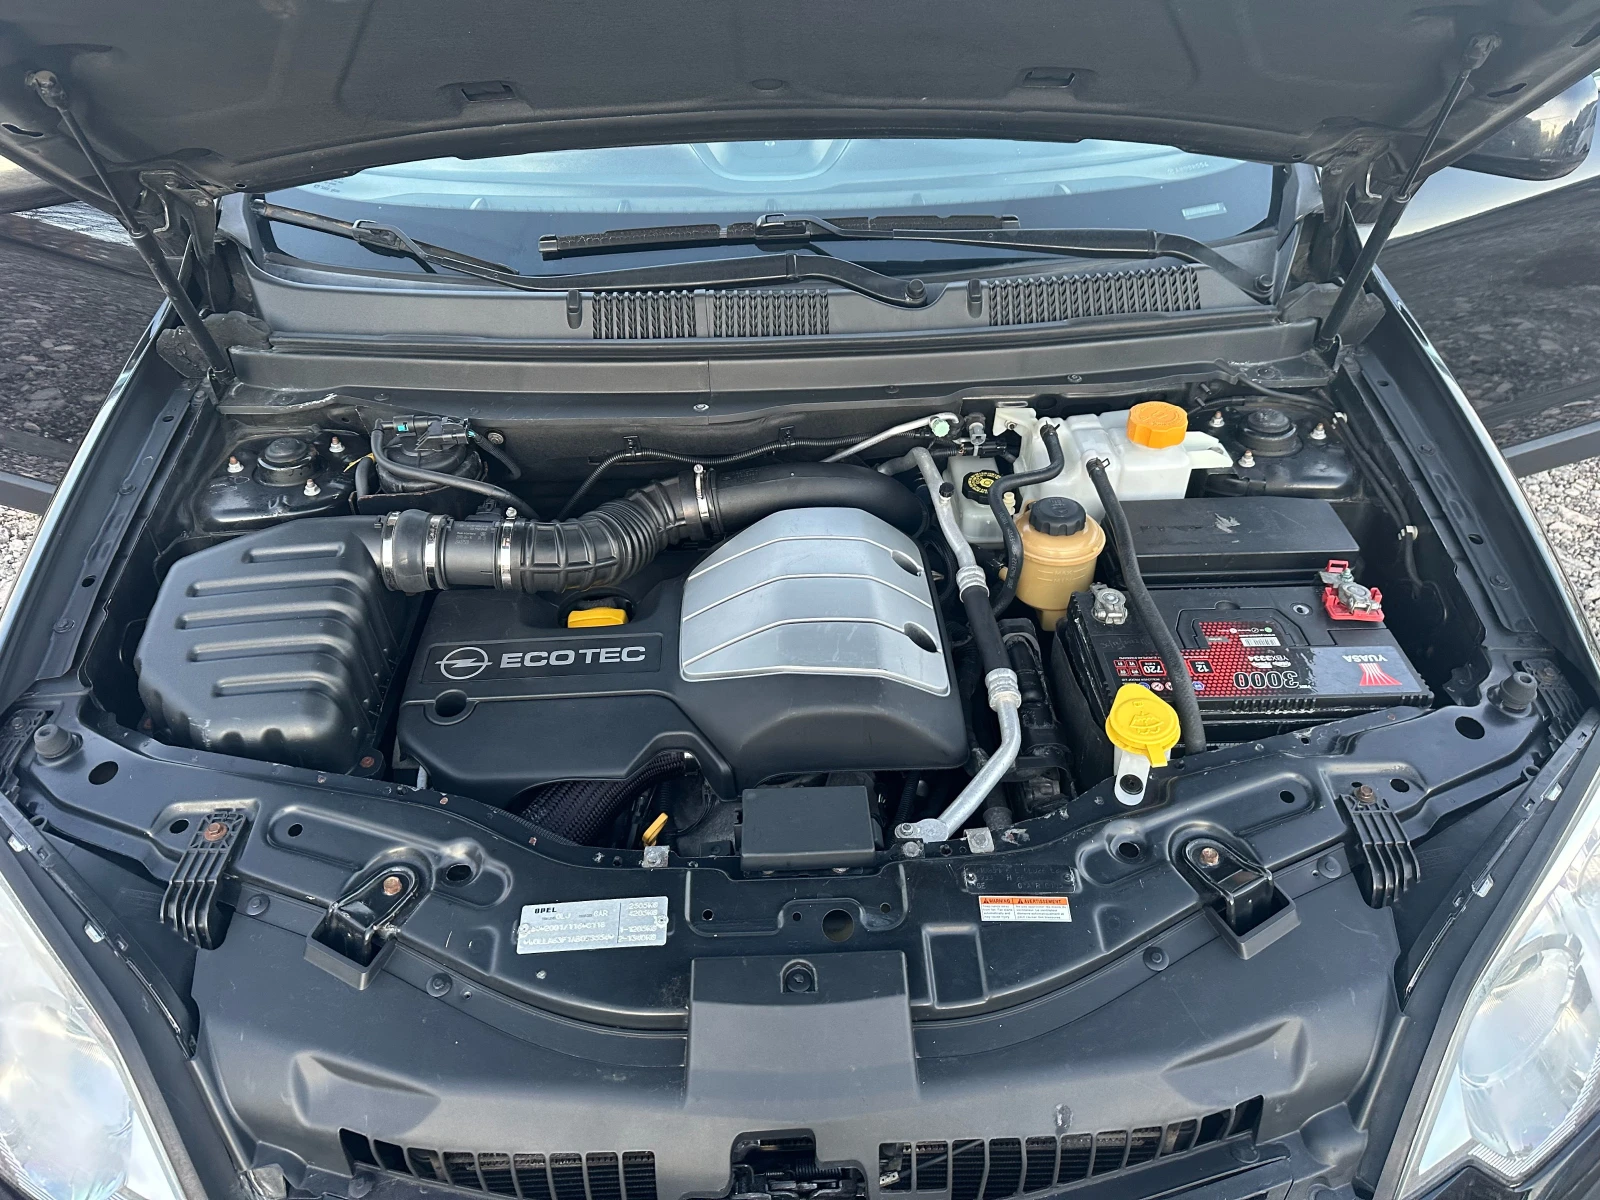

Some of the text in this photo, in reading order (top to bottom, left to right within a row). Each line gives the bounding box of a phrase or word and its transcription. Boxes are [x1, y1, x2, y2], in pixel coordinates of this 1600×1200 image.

[500, 646, 646, 669] ECOTEC
[1342, 654, 1389, 663] YUASA
[1143, 665, 1164, 674] 720
[1195, 664, 1210, 673] 12
[1233, 671, 1300, 690] 3000
[534, 906, 557, 914] OPEL
